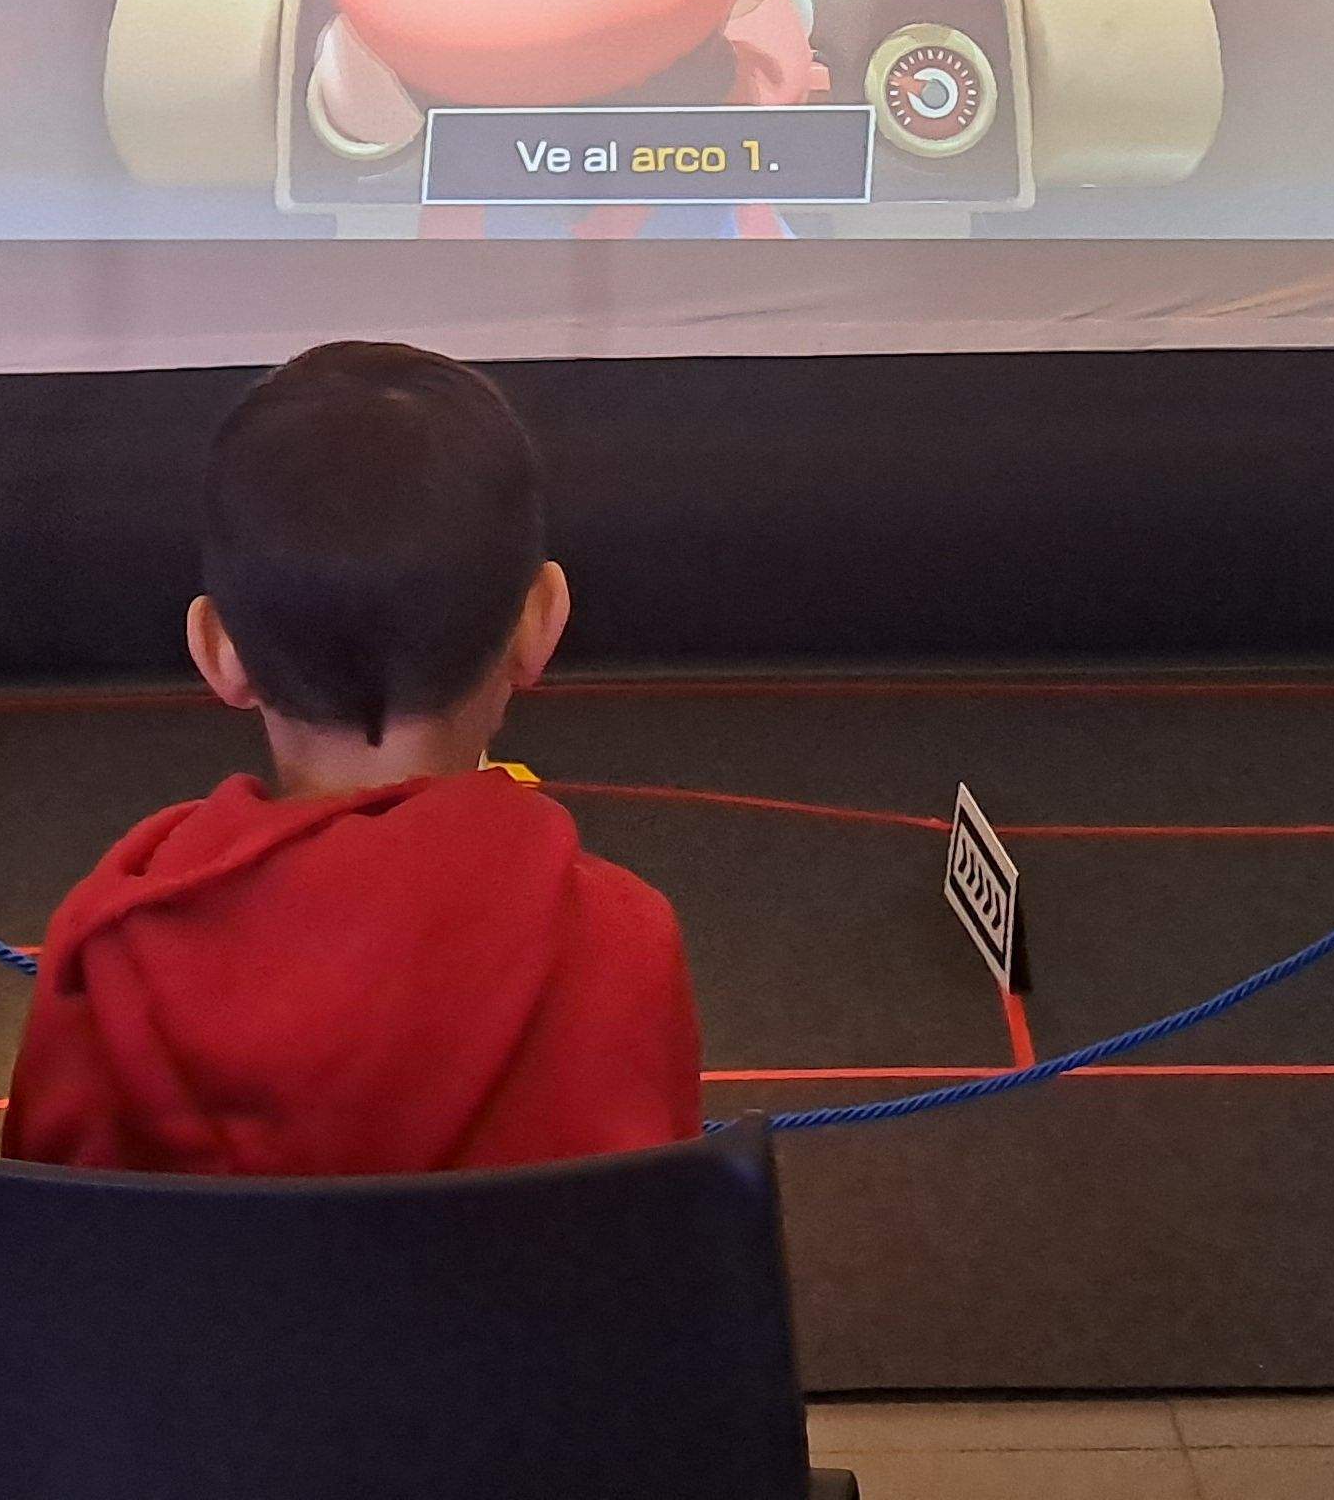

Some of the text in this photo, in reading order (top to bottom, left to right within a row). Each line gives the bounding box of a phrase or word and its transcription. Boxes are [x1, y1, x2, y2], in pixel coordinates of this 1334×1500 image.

[517, 140, 779, 173] Ve al arco 1.
